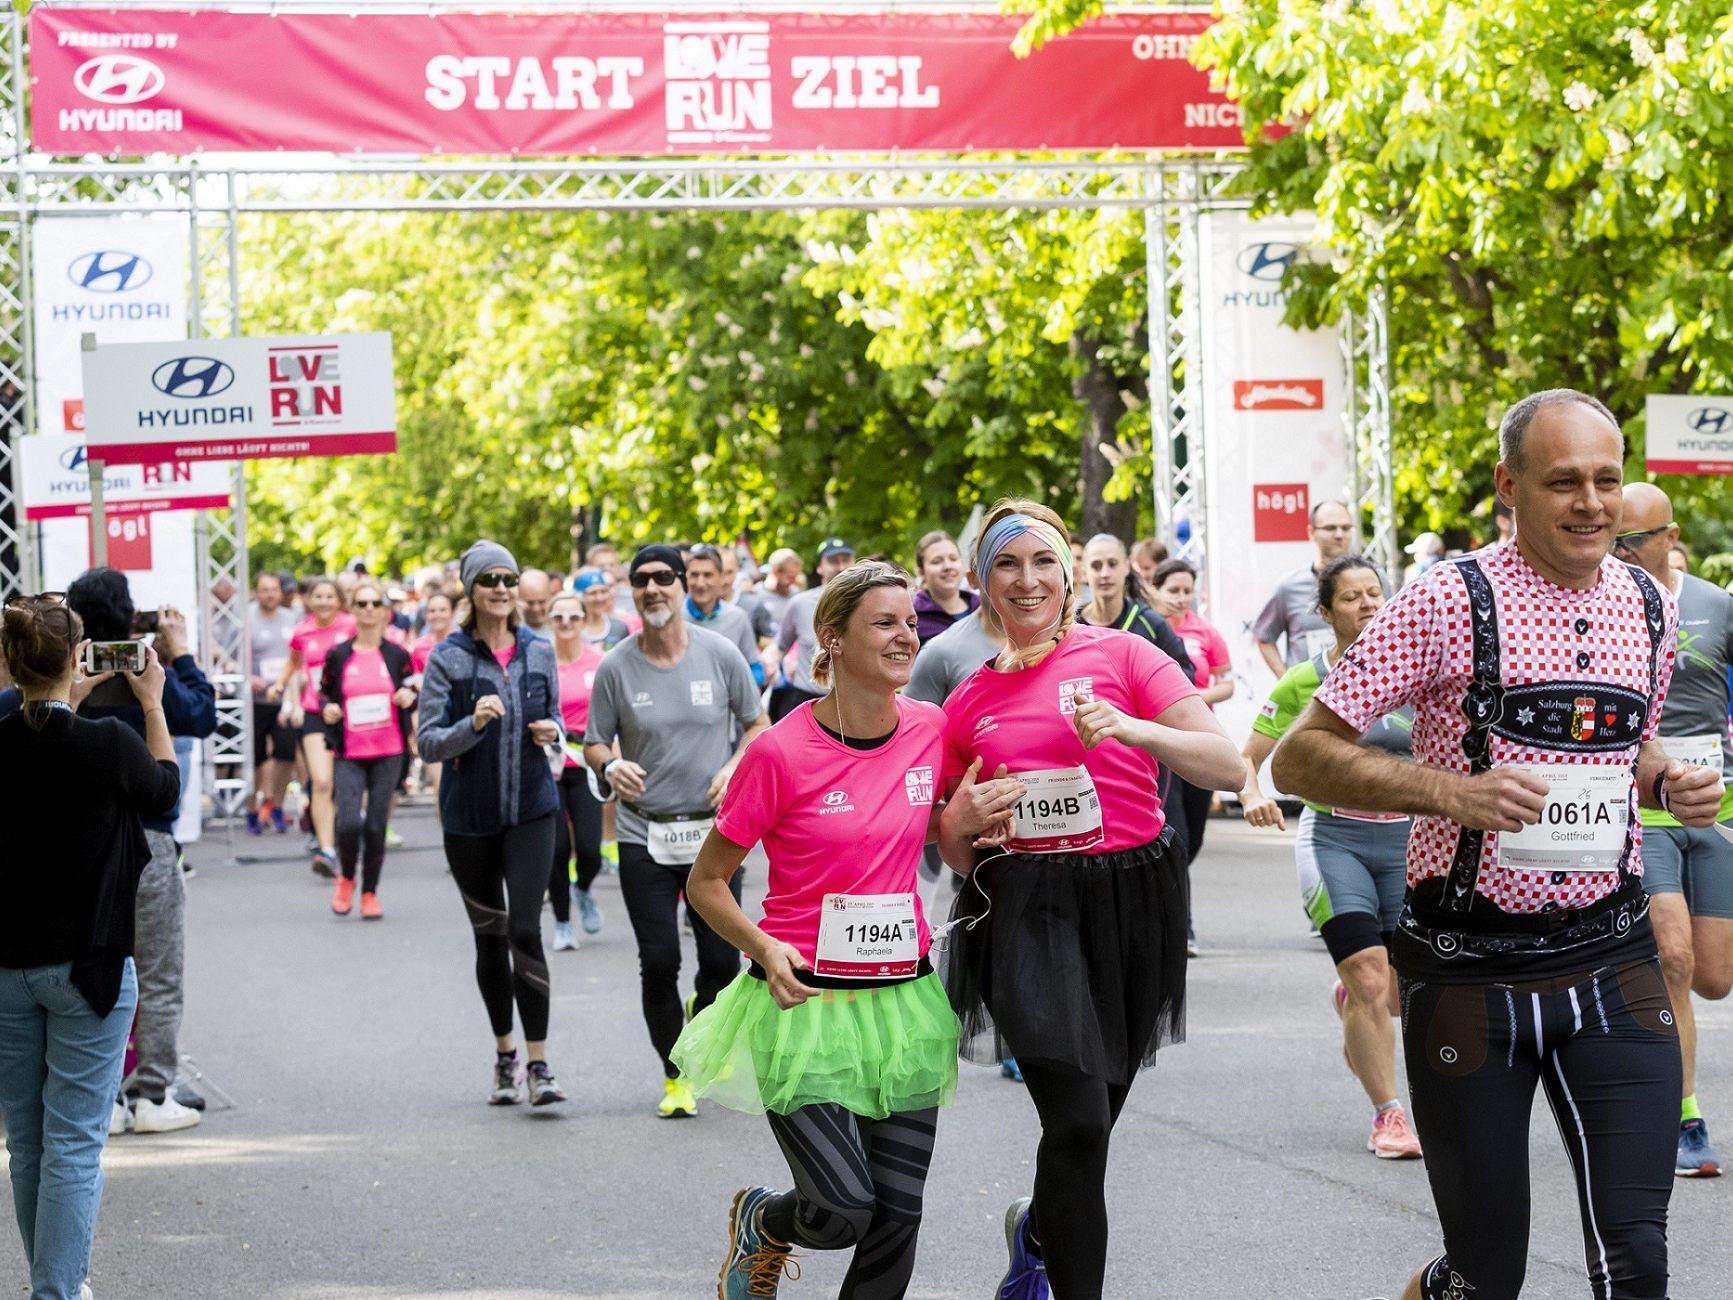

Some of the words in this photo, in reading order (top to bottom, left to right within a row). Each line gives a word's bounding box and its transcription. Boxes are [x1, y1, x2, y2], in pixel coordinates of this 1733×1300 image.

[58, 32, 153, 48] PRESENTED
[155, 33, 178, 48] BY
[664, 34, 771, 79] LOVE
[424, 56, 643, 111] START
[791, 56, 940, 108] ZIEL
[665, 80, 772, 130] RUN
[59, 109, 182, 132] HYUNDAI
[53, 304, 170, 320] HYUNDAI
[269, 354, 340, 383] LOVE
[271, 385, 342, 417] RUN
[138, 406, 253, 428] HYUNDAI
[1257, 490, 1305, 514] högl
[1538, 699, 1572, 711] Salzburg
[1604, 703, 1617, 712] mit
[1548, 712, 1561, 722] die
[1543, 725, 1563, 734] Stadt
[1600, 728, 1616, 736] Herz
[906, 785, 933, 803] RUN
[819, 804, 855, 815] HYUNDAI
[1015, 797, 1081, 820] 1194B
[1032, 821, 1067, 832] Theresa
[1551, 830, 1595, 842] Gottfried
[845, 922, 903, 944] 1194A
[856, 946, 892, 958] Raphaela
